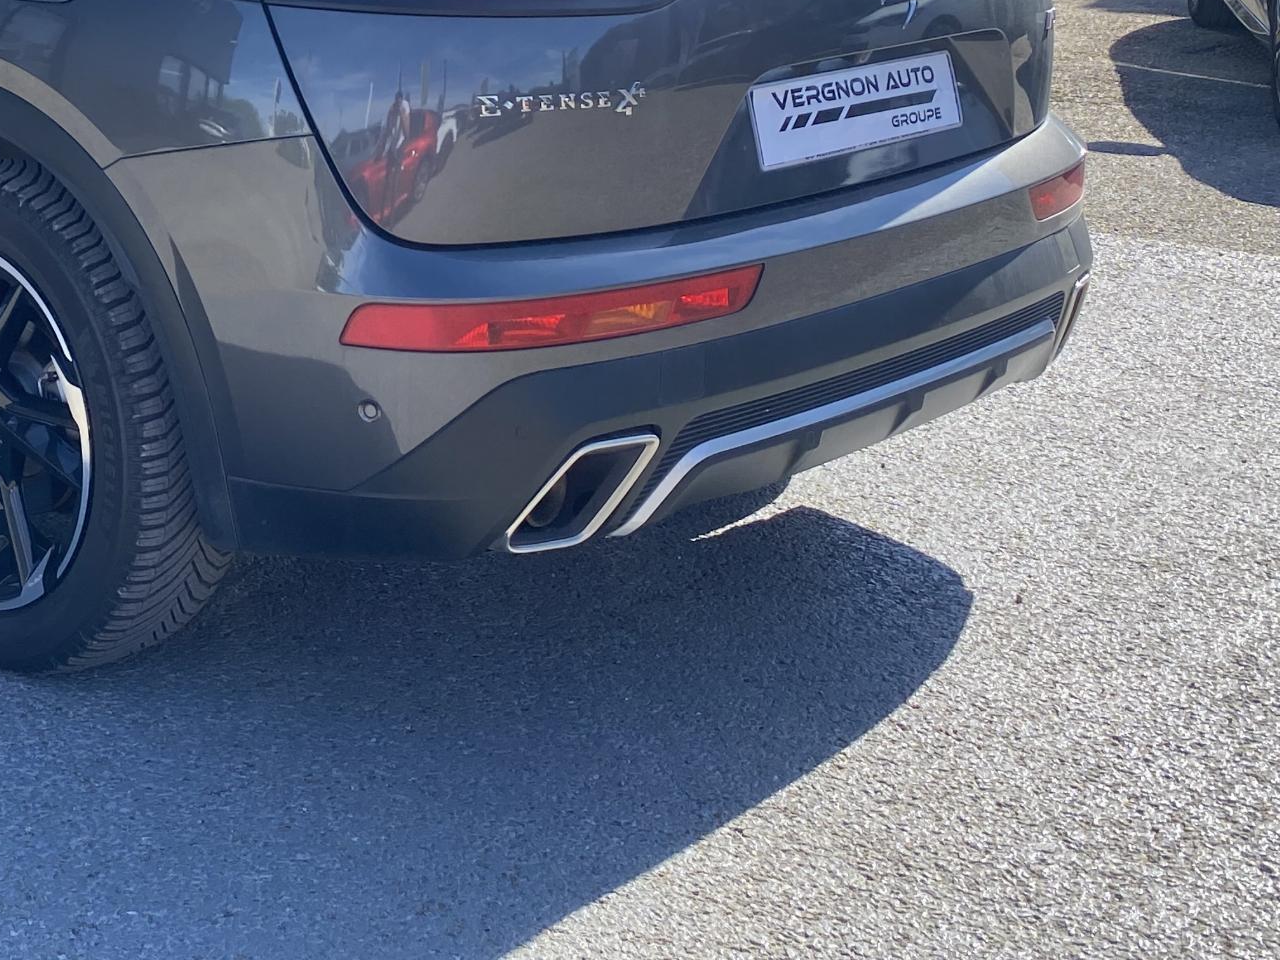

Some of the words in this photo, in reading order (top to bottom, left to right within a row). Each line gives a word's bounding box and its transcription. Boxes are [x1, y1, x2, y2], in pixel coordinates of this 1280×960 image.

[771, 74, 880, 110] VERGNON
[886, 65, 934, 91] AUTO
[891, 107, 942, 127] GROUPE
